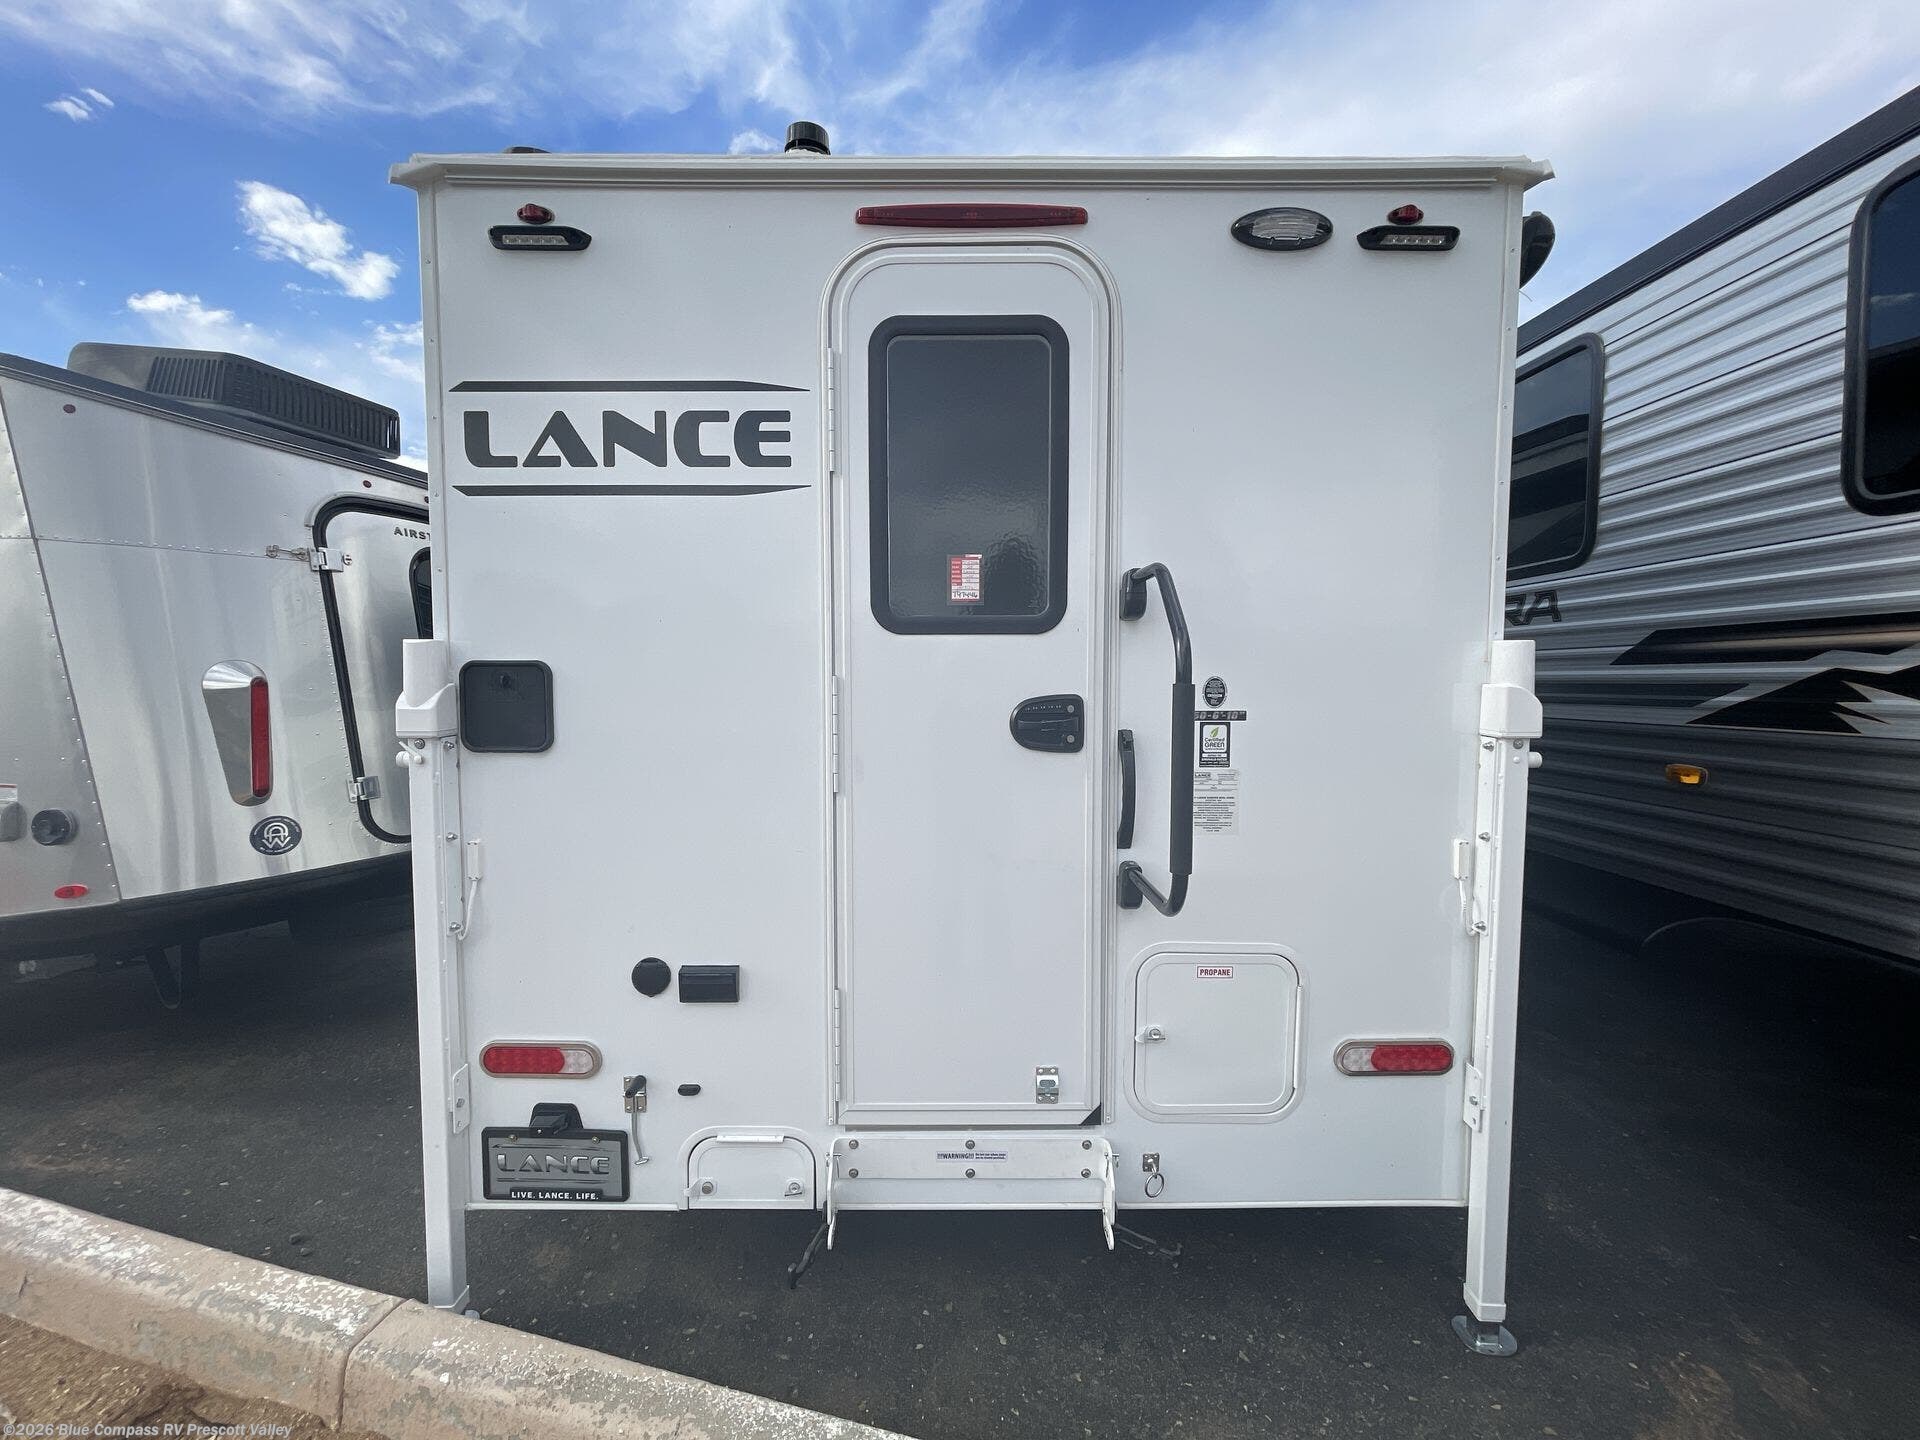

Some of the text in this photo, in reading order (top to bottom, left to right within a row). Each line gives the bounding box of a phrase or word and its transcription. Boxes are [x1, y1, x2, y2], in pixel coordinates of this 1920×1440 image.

[463, 410, 792, 468] LANCE
[1199, 968, 1231, 976] PROPANE
[497, 1154, 610, 1174] LANCE
[511, 1191, 599, 1200] LIVE. LANCE. LIFE.
